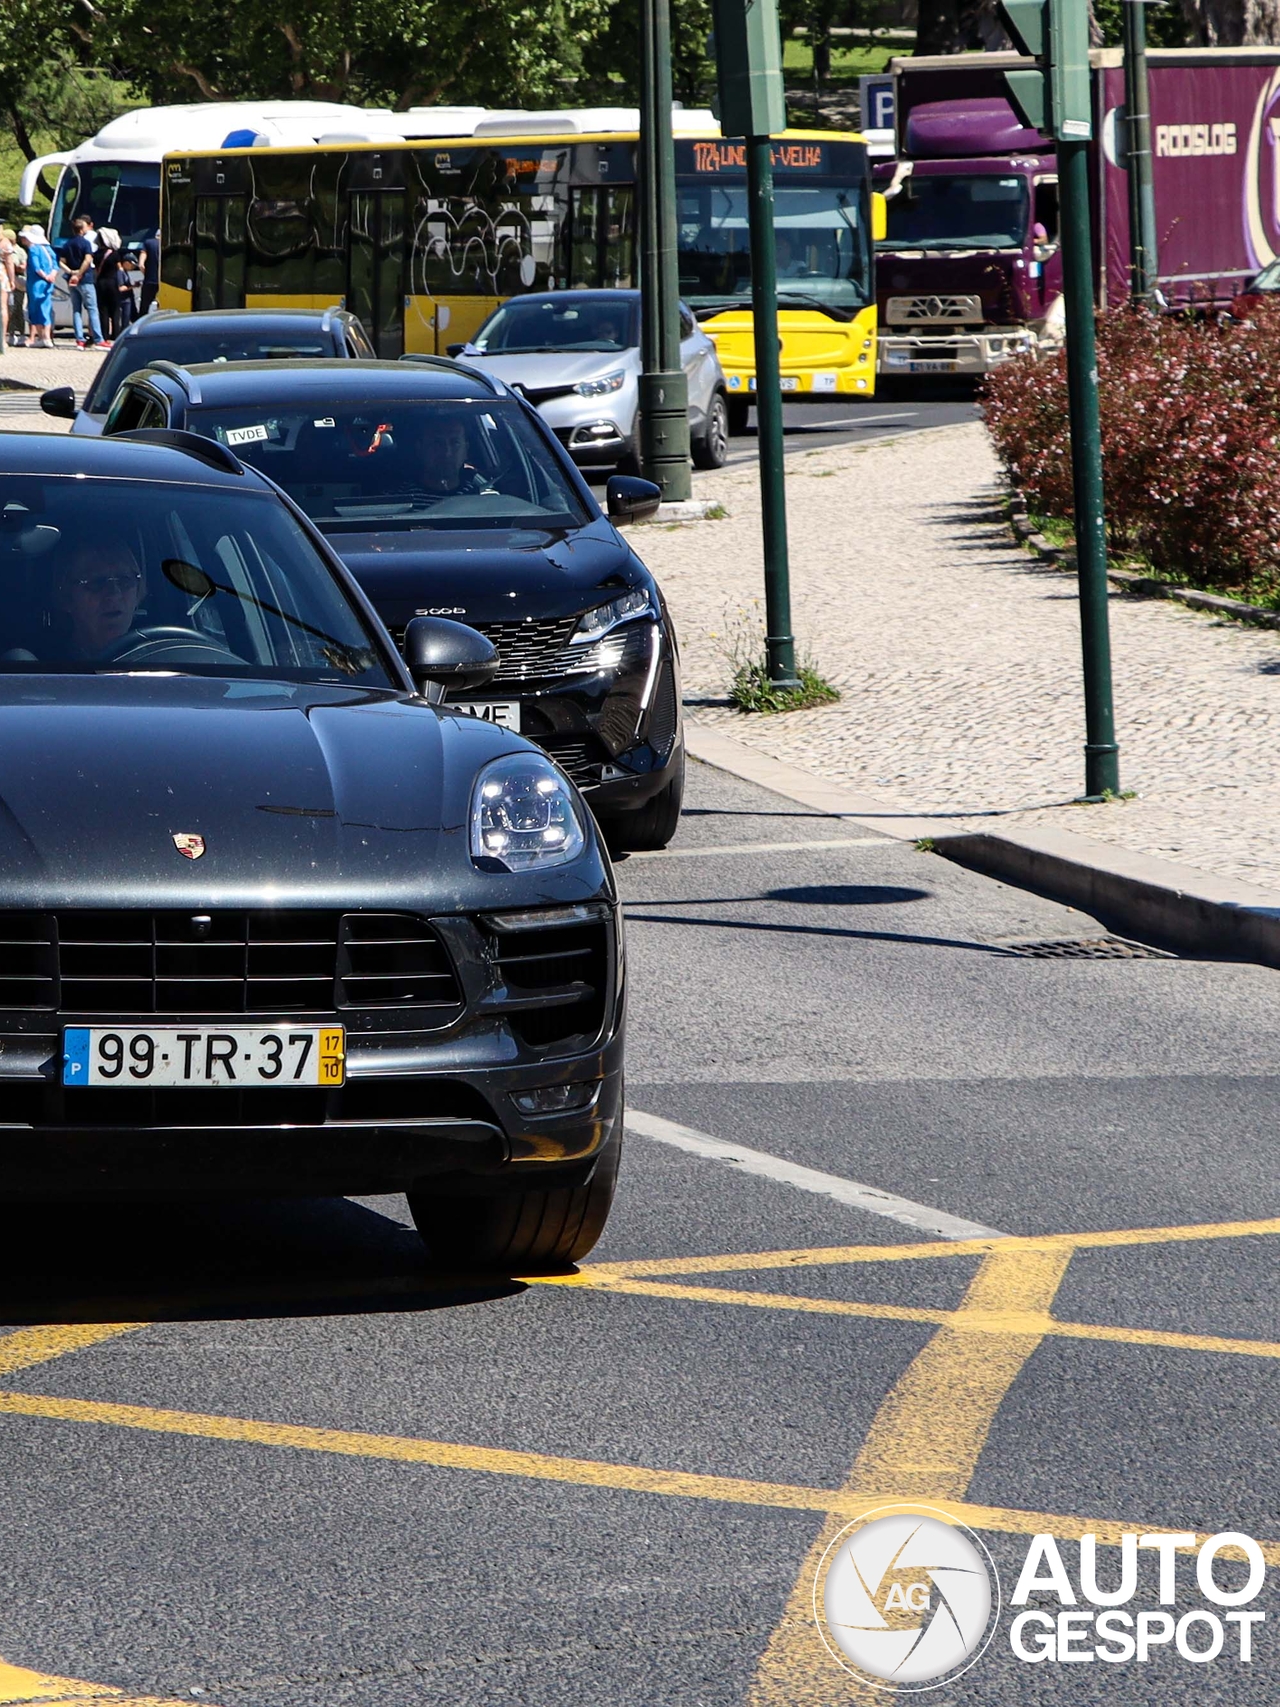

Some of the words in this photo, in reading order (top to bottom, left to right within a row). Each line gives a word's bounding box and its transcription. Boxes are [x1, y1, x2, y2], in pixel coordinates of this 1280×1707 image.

[876, 91, 895, 128] P
[824, 377, 836, 386] TP
[231, 428, 264, 443] TVDE
[325, 1036, 340, 1051] 17
[71, 1062, 82, 1076] P
[324, 1063, 339, 1078] 10
